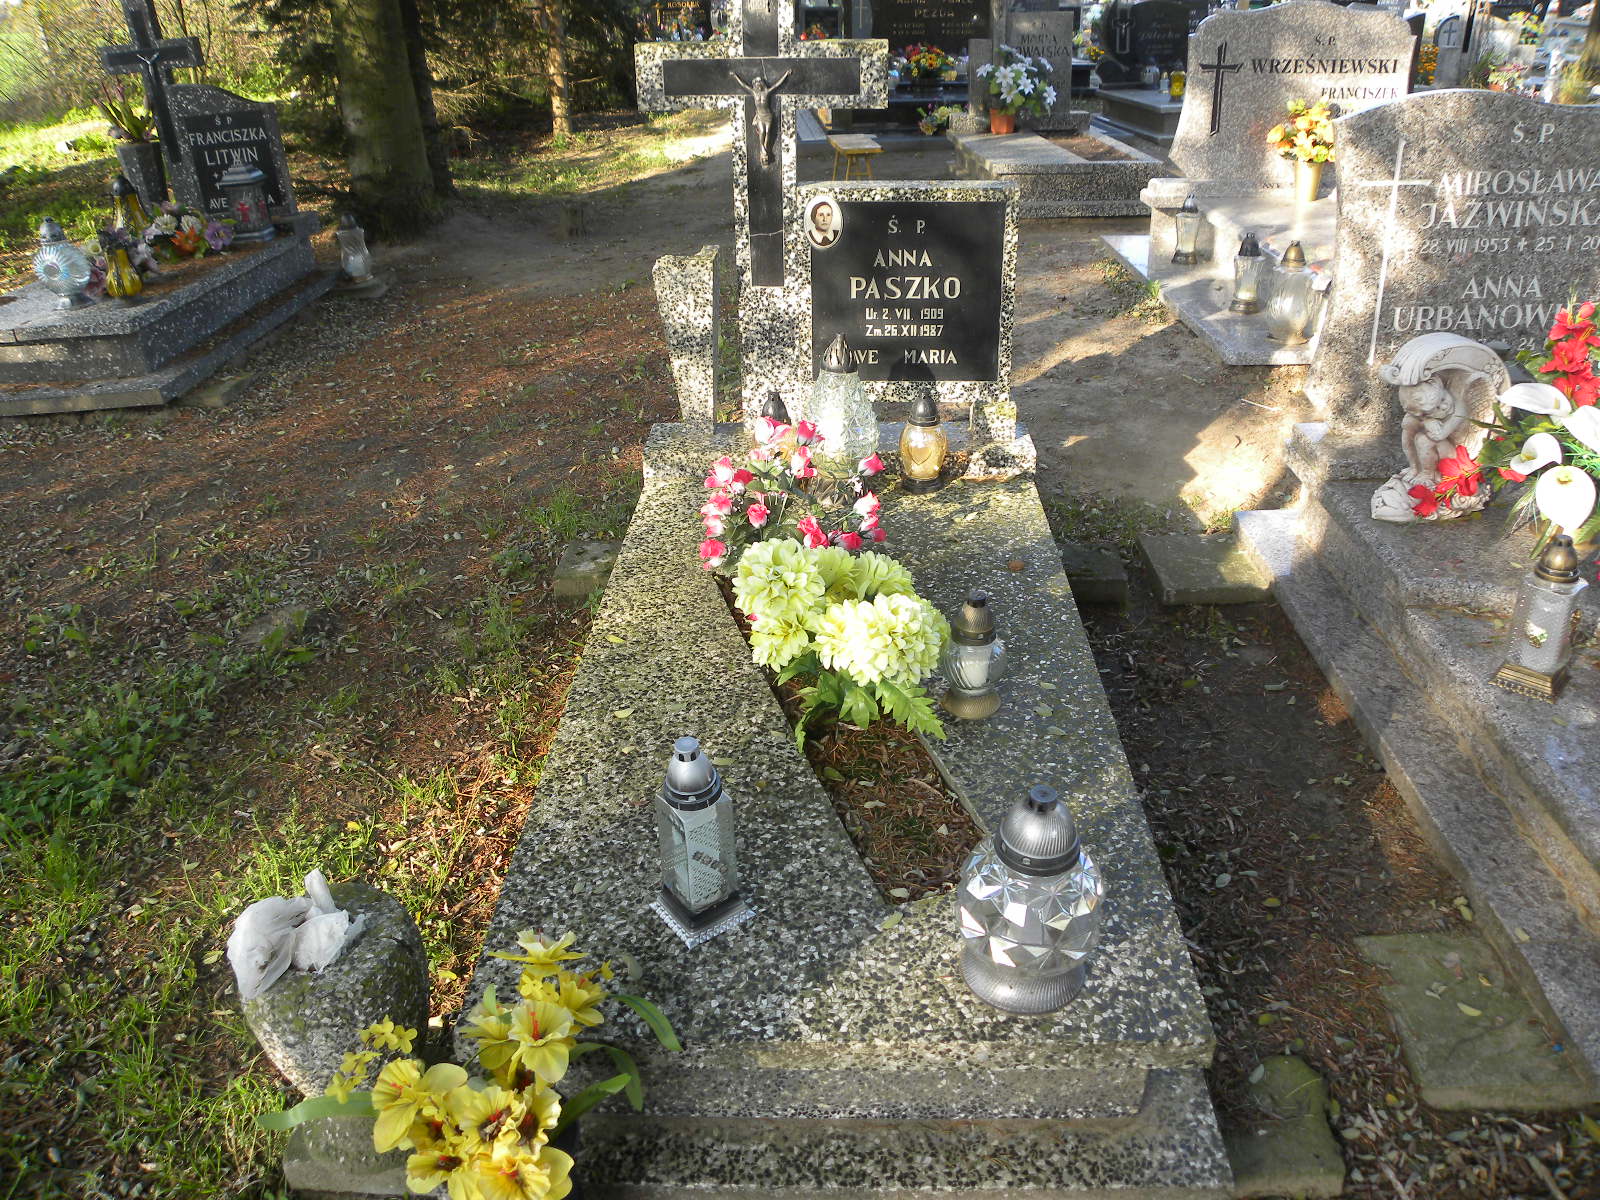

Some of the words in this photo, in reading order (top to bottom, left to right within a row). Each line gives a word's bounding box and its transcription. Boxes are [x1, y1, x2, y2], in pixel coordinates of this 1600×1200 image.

[1251, 54, 1398, 74] WRZEŚNIEWSKI
[1321, 87, 1398, 99] FRANCISZEK
[188, 128, 267, 147] FRANCISZKA
[204, 146, 259, 166] LITWIN
[209, 198, 227, 209] AVE
[873, 249, 933, 268] ANNA
[850, 276, 961, 300] PASZKO
[1461, 275, 1543, 299] ANNA
[920, 308, 944, 320] 1909
[904, 349, 958, 365] MARIA
